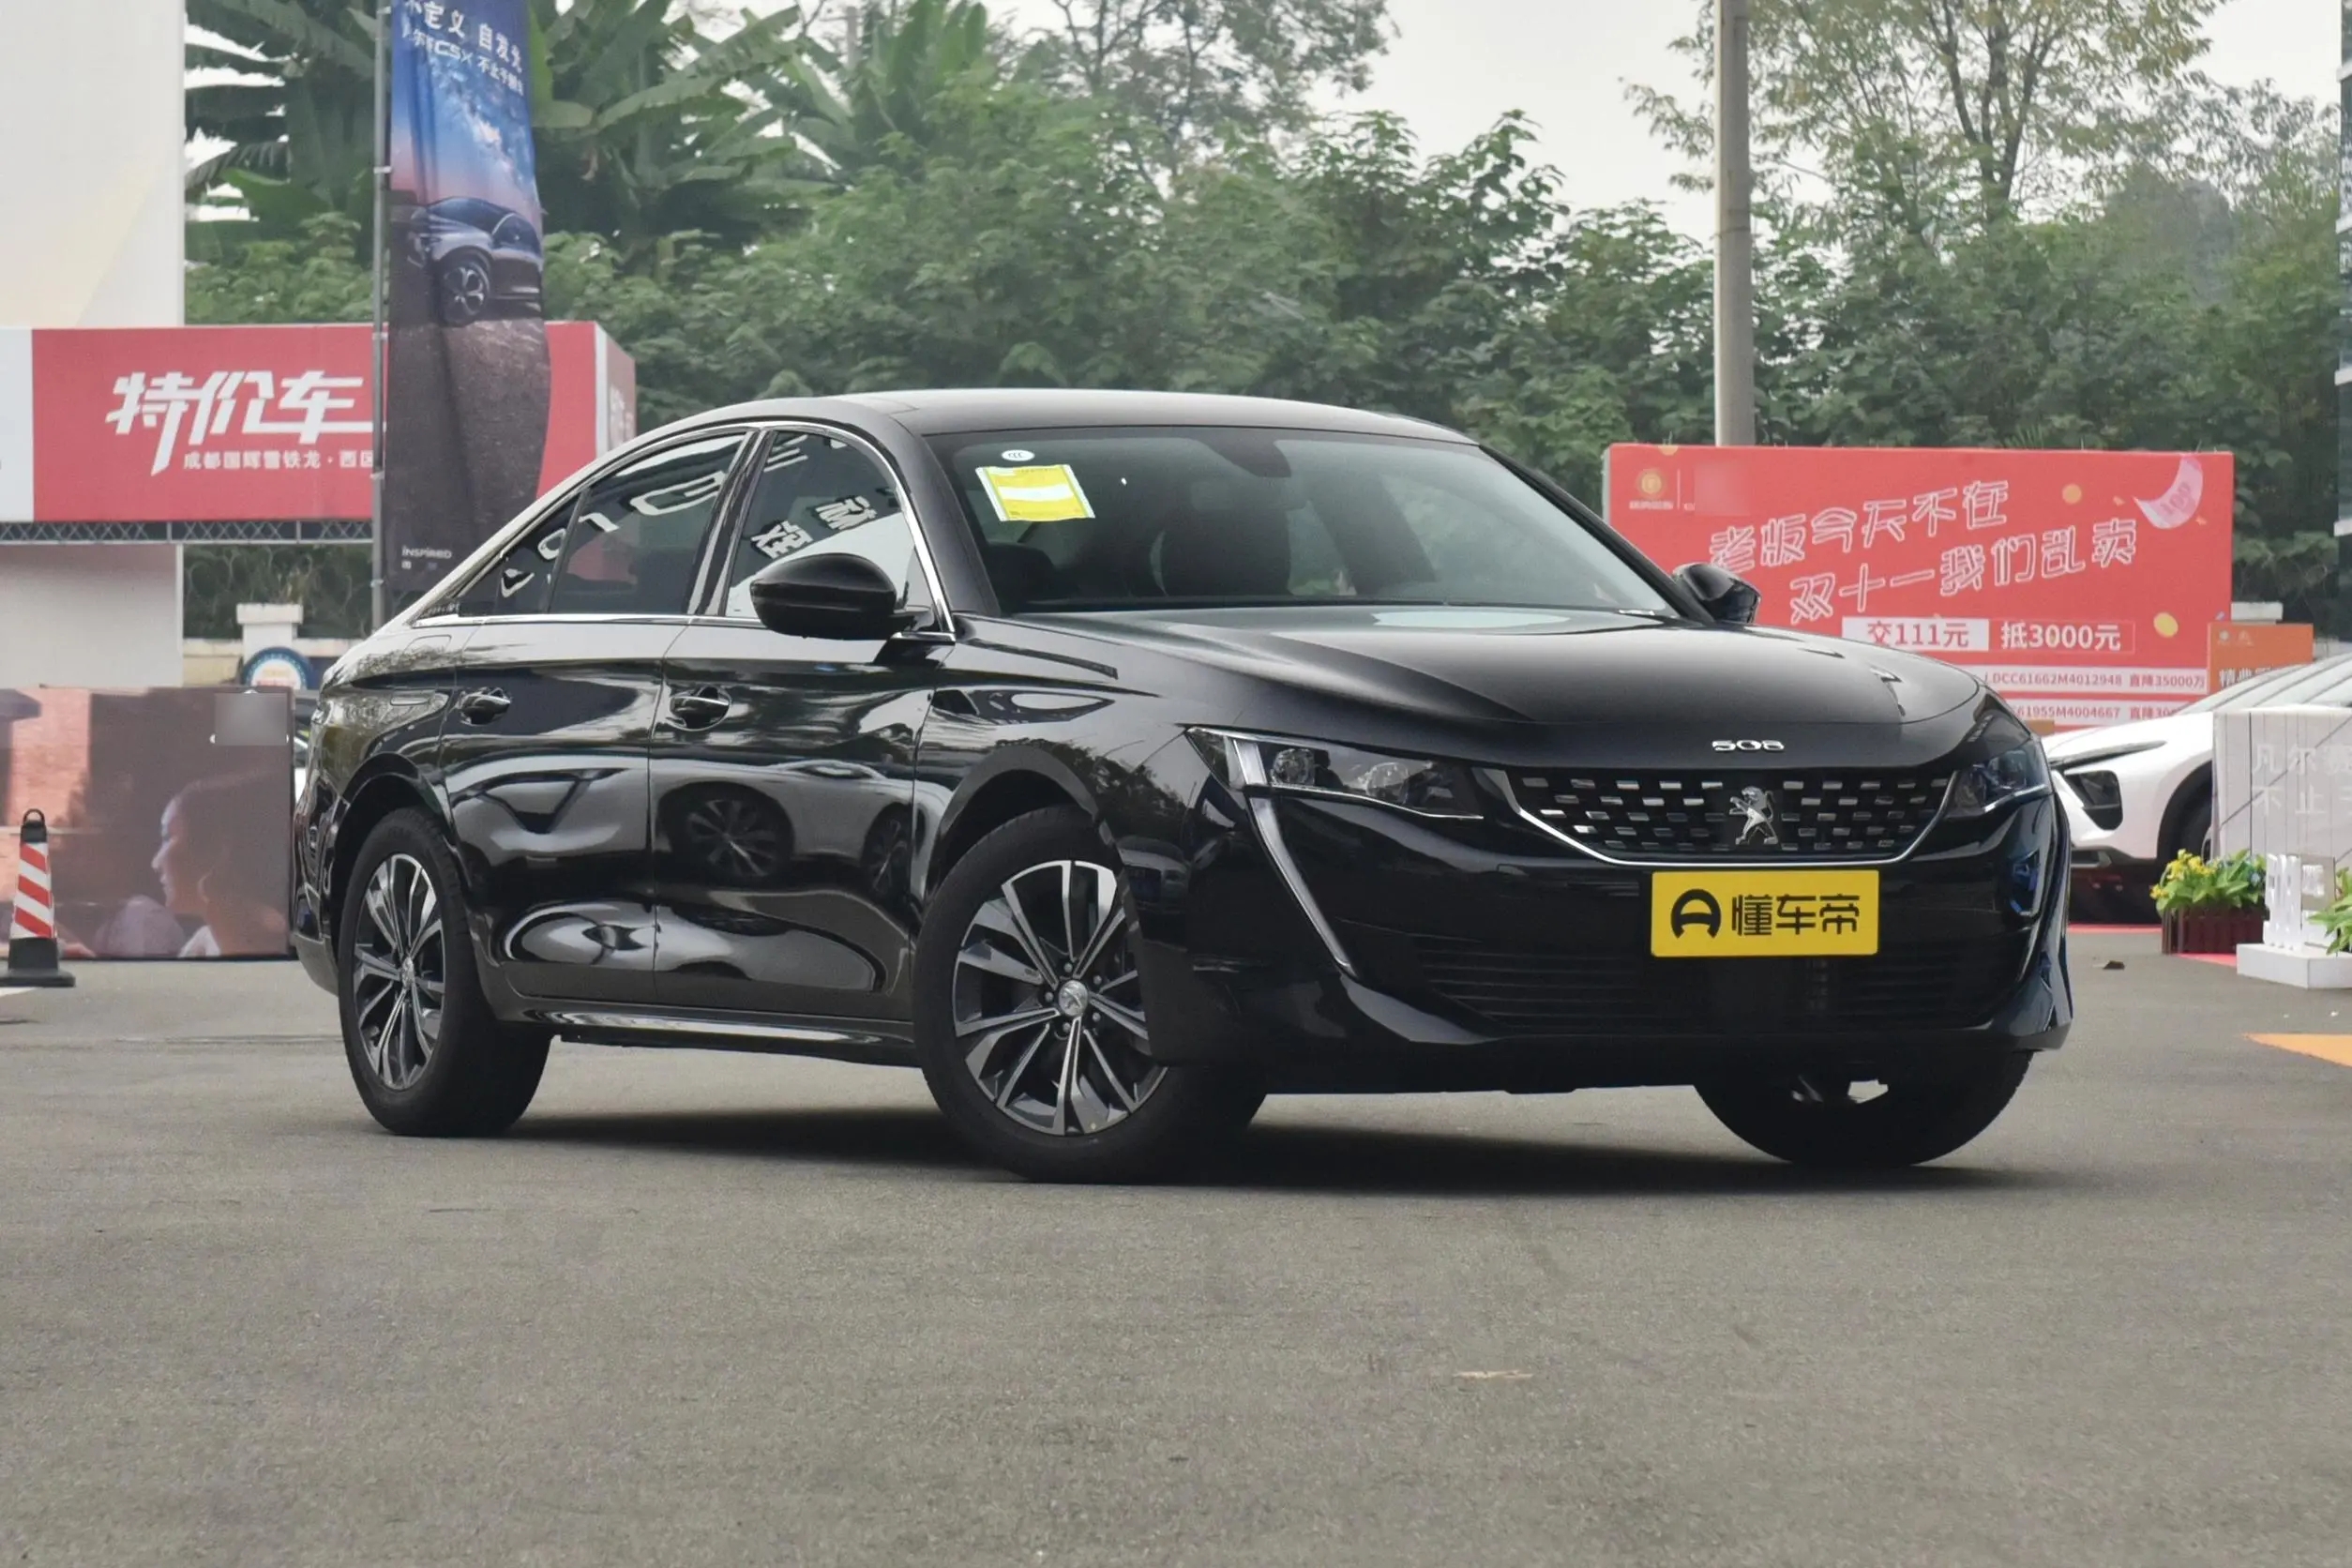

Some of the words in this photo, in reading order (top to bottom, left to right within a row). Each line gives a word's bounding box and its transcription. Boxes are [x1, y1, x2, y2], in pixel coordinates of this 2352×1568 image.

[105, 370, 386, 476] 特价车
[1710, 480, 2009, 574] 老板今天不在
[1788, 517, 2136, 626] 双十一我们乱卖
[1865, 620, 1969, 648] 交111元
[2000, 621, 2121, 650] 抵3000元
[1711, 739, 1785, 751] 508
[1731, 893, 1861, 937] 懂车帝
